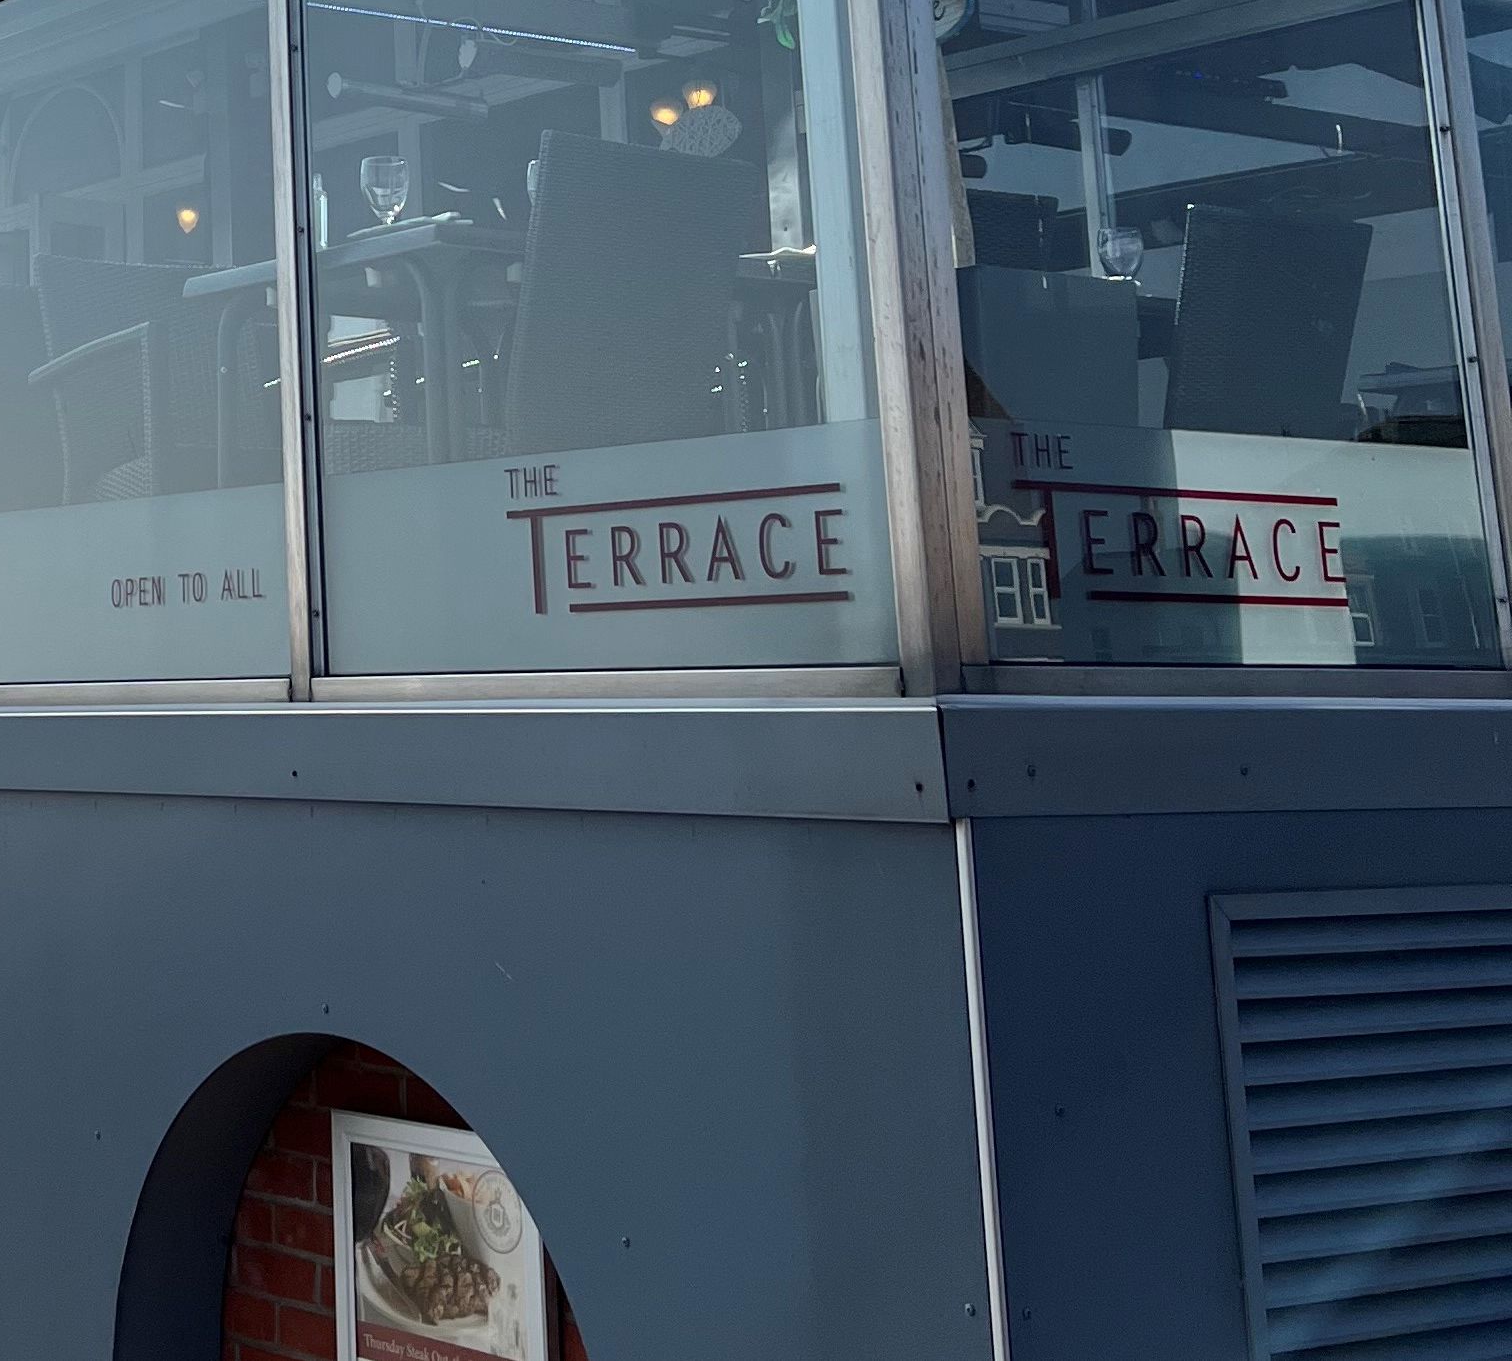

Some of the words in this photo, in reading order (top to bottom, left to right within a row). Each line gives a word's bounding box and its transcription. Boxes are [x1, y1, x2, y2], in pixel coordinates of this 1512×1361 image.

[1012, 432, 1074, 469] THE
[504, 464, 559, 498] THE
[506, 483, 849, 614] TERRACE
[1012, 479, 1346, 598] TERRACE
[111, 576, 164, 608] OPEN
[178, 572, 206, 604] TO
[221, 568, 264, 600] ALL
[363, 1333, 405, 1358] Thursday
[405, 1342, 430, 1361] Steak
